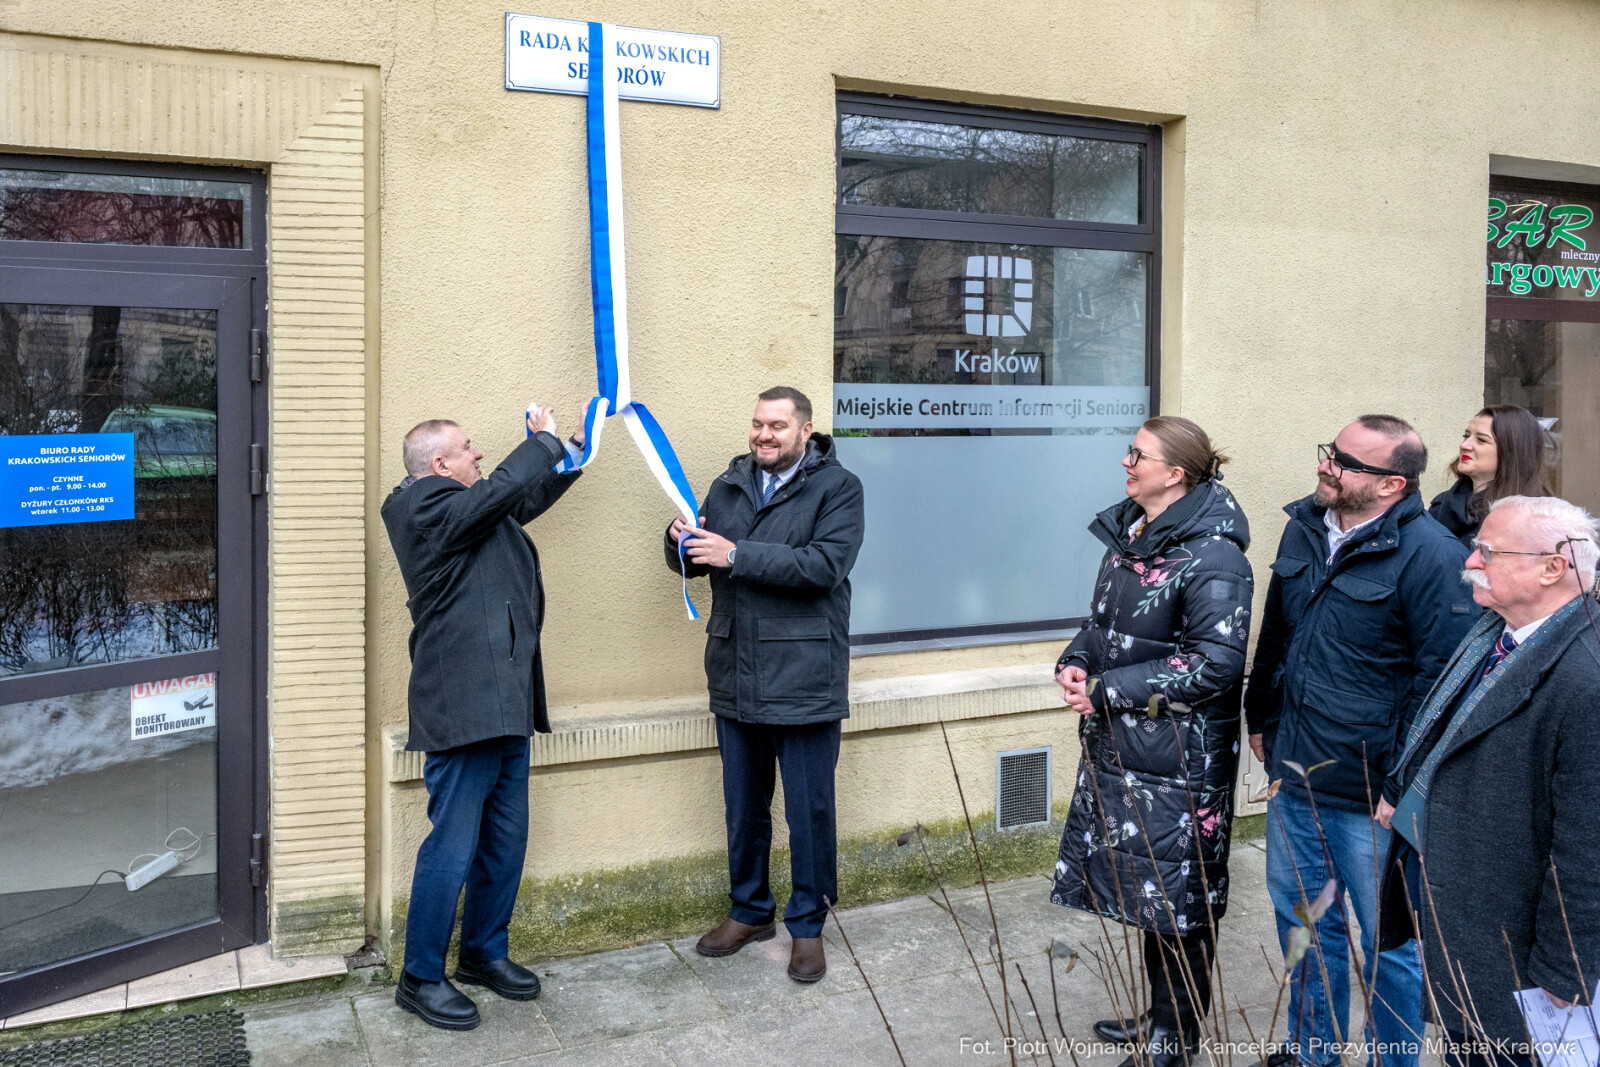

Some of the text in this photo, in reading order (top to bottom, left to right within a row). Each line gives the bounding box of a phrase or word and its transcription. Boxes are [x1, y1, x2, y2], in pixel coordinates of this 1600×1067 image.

[519, 30, 711, 66] RADA KKOWSKICH
[567, 61, 666, 87] SERÓW
[1561, 249, 1600, 264] mleczny
[1486, 262, 1600, 297] rgowy
[955, 348, 1040, 373] Kraków
[836, 397, 913, 419] Miejskie
[918, 399, 993, 416] Centrum
[1086, 399, 1146, 416] Seniora
[8, 453, 126, 465] KRAKOWSKICH SENIORÓW
[40, 446, 96, 455] BIURO RADY
[21, 499, 53, 508] DYŻURY
[54, 497, 98, 506] CZŁONKÓW
[134, 672, 215, 698] UWAGA!
[135, 713, 167, 727] OBIEKT
[135, 716, 206, 736] MONITOROWANY
